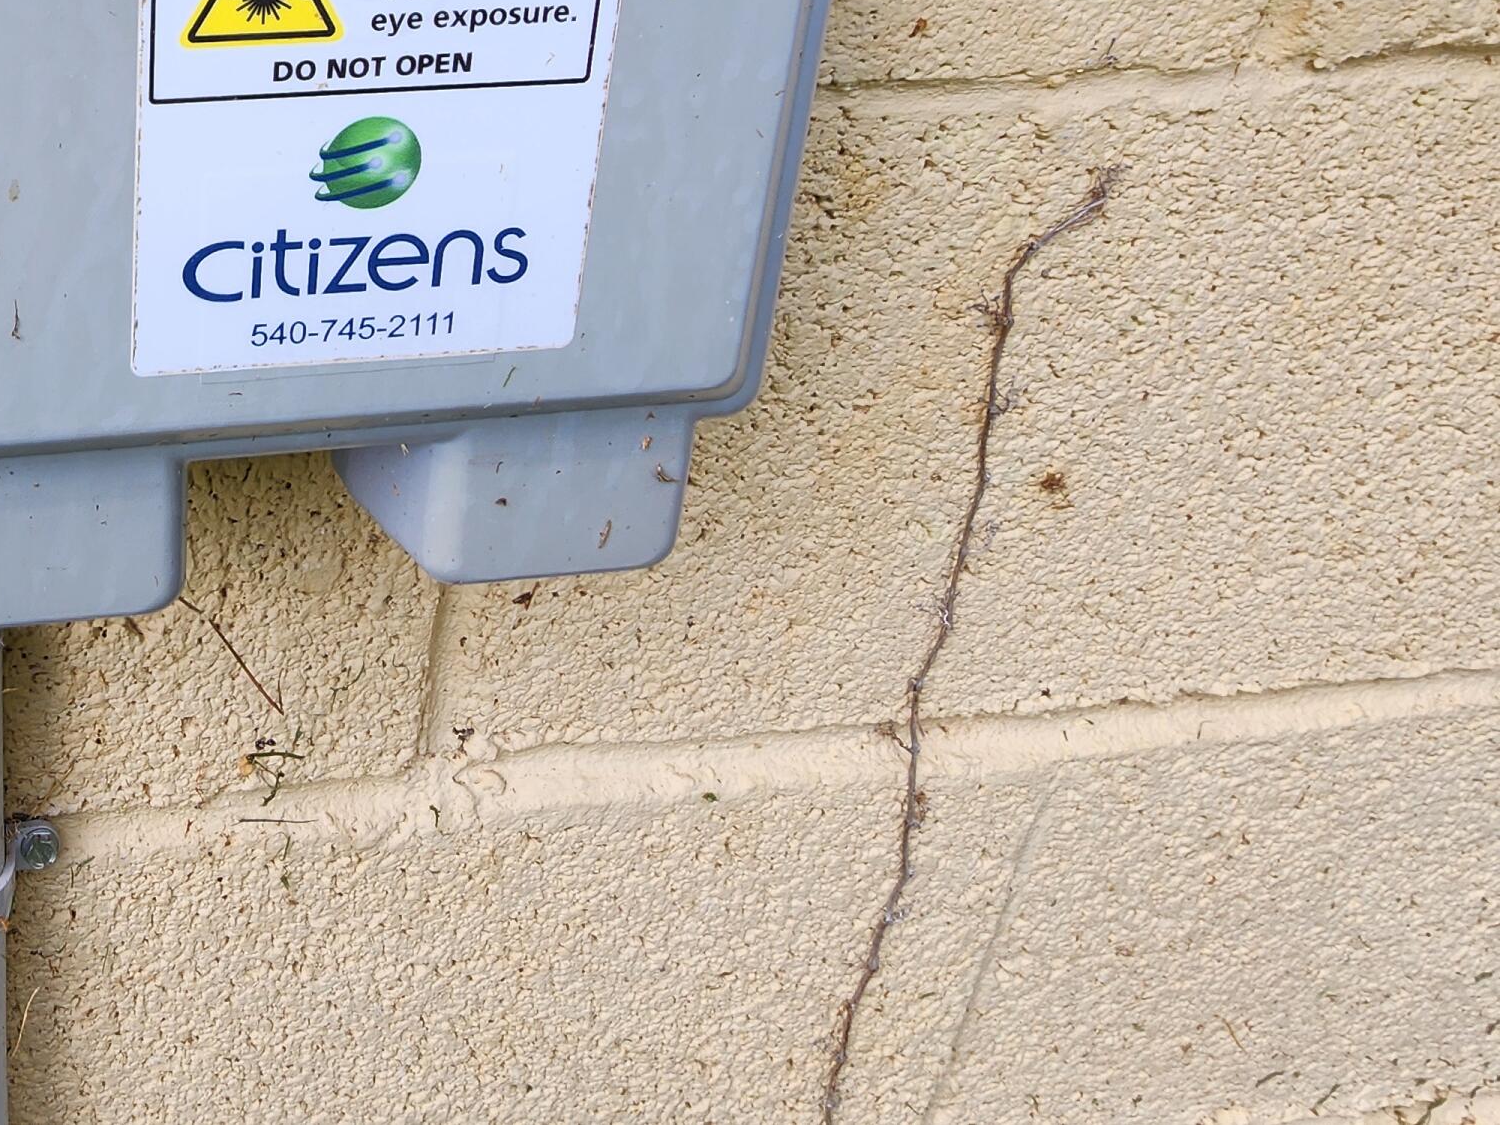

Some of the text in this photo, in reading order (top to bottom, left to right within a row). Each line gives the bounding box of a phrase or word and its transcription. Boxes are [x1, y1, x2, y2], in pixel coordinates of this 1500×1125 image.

[371, 5, 577, 37] eye exposure.
[272, 51, 473, 82] DO NOT OPEN
[251, 311, 454, 347] 540-745-2111
